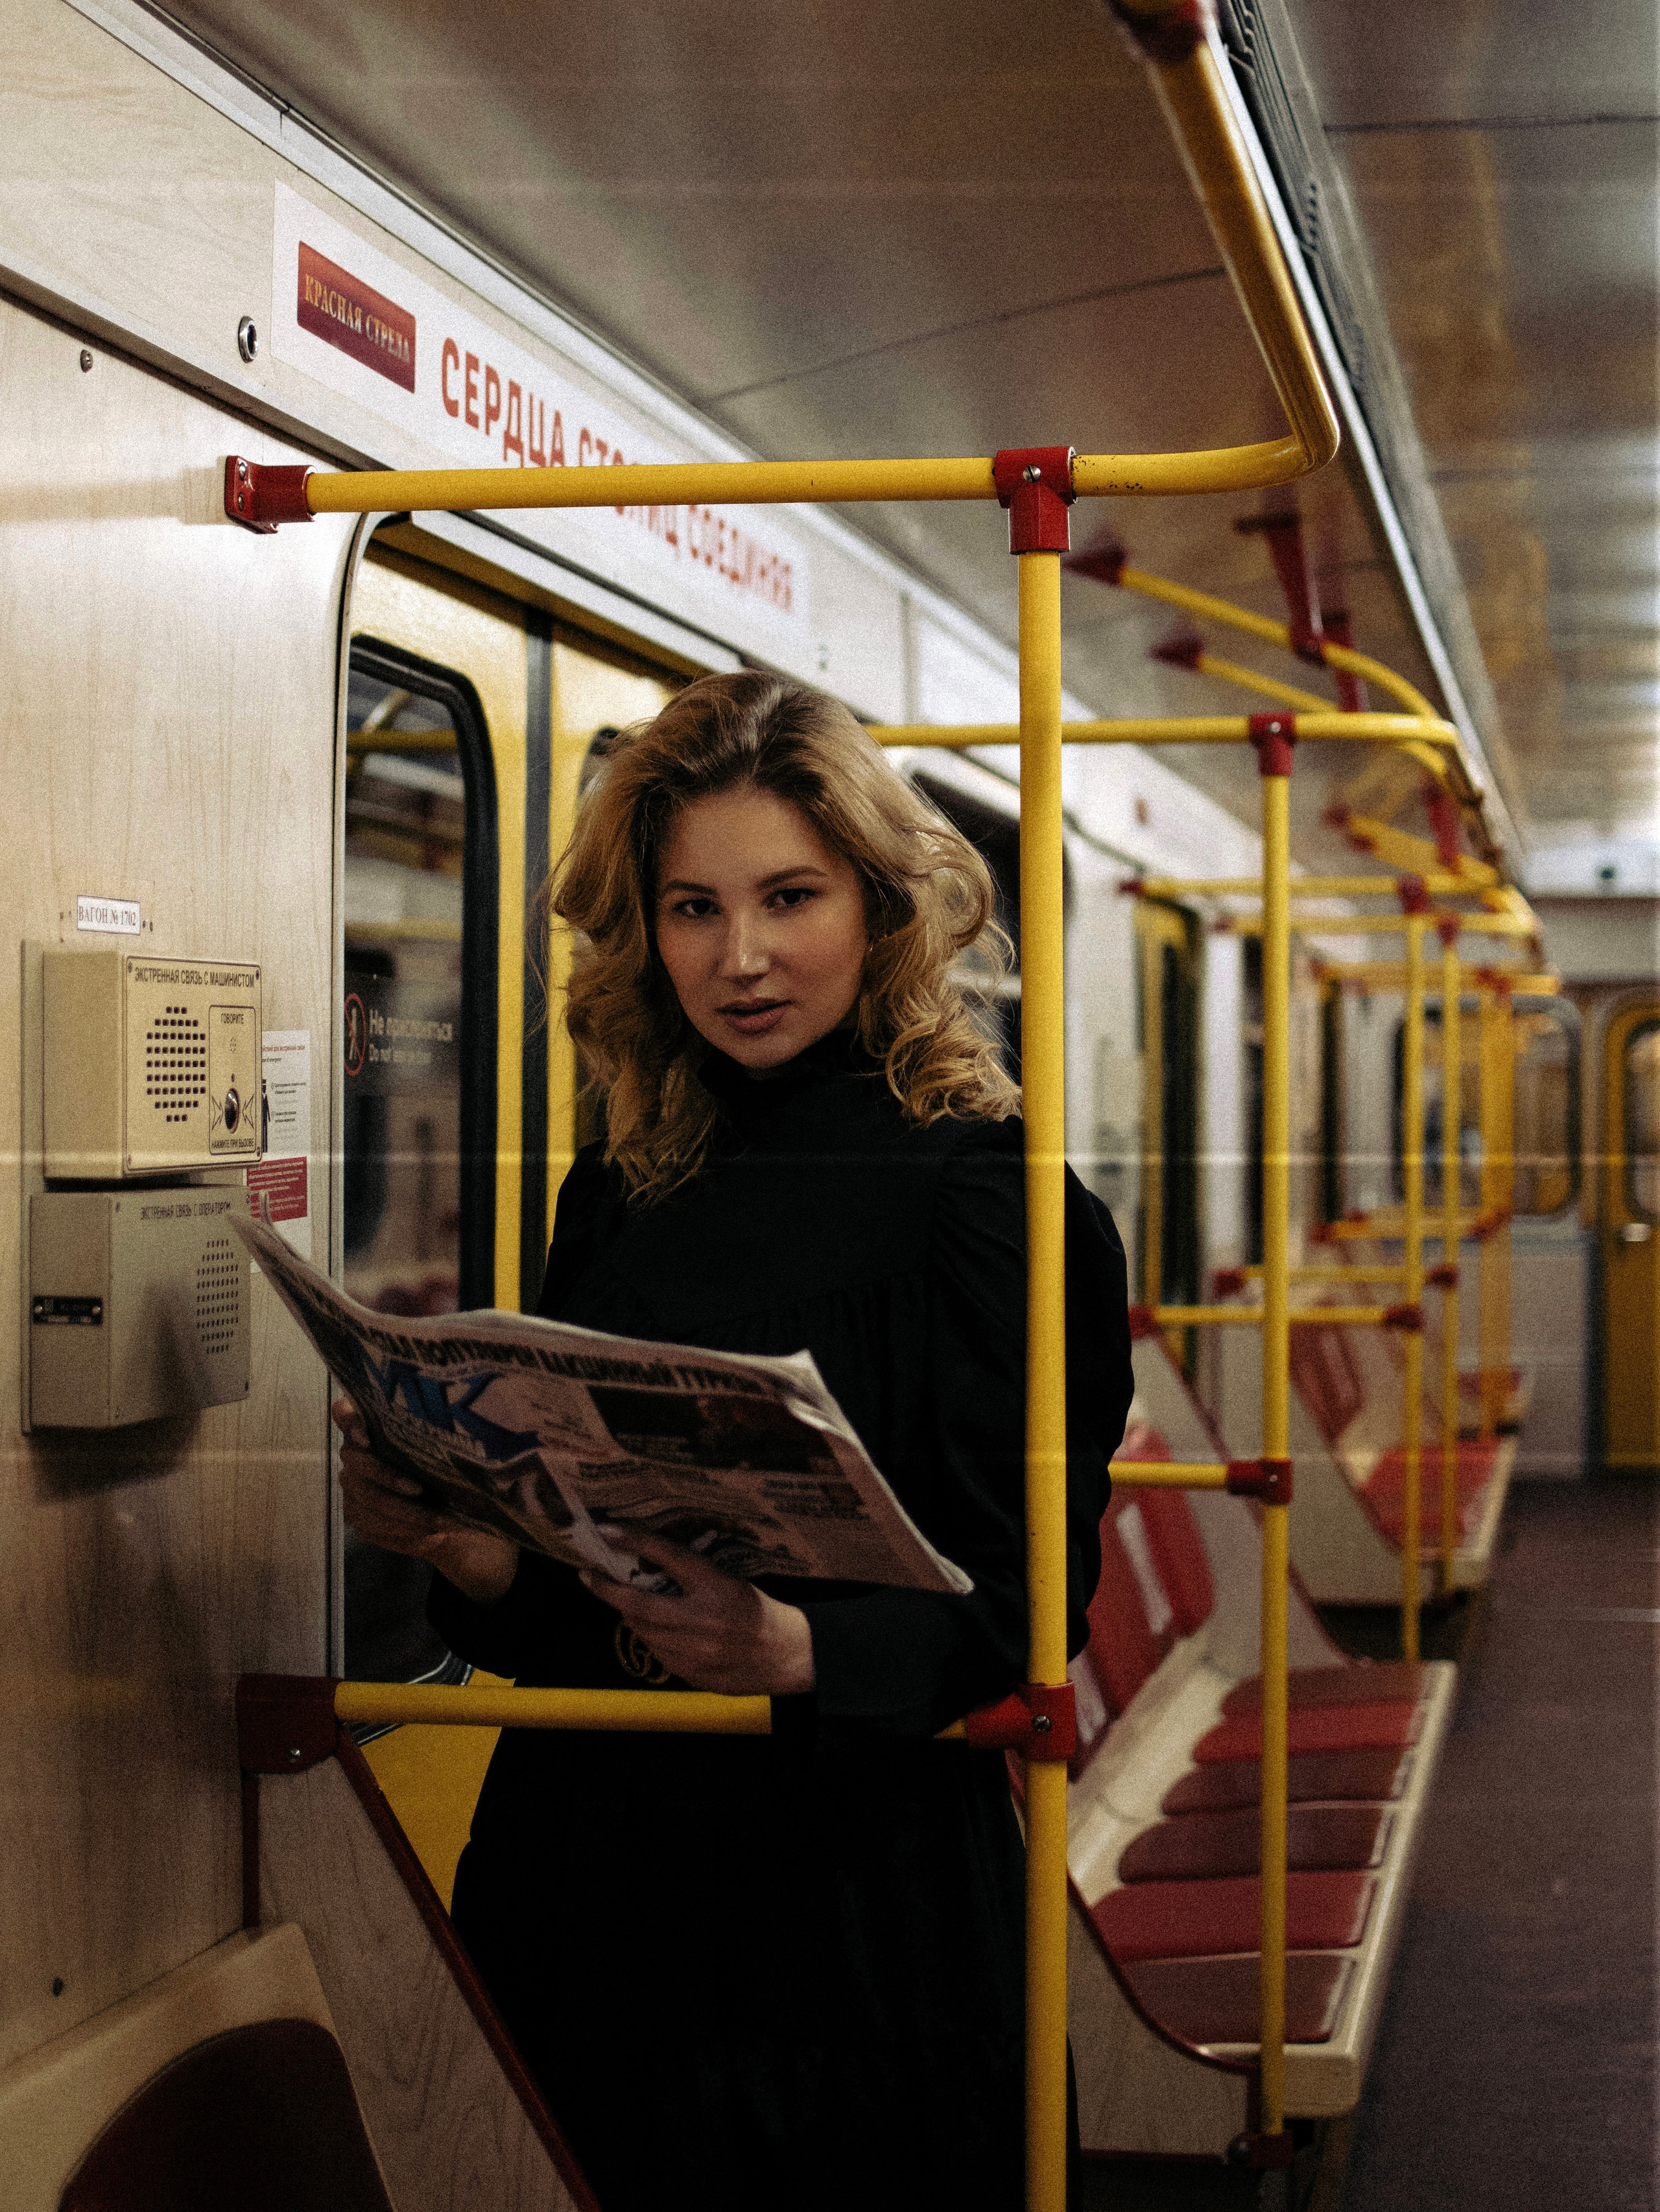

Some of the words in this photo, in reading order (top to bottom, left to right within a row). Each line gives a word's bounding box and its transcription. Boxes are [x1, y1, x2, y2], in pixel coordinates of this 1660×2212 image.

[305, 274, 362, 333] КРАСНАЯ
[366, 314, 410, 363] СТРЕЛА
[442, 337, 565, 467] СЕРДЦА
[78, 906, 108, 924] ВАГОН
[121, 912, 136, 926] 1702
[135, 967, 180, 985] ЭКСТРЕННАЯ
[182, 970, 202, 985] СВЯЗЬ
[204, 972, 209, 985] С
[209, 972, 254, 988] МАШИНИСТОМ
[141, 1205, 174, 1220] ЭКСТРЕННАЯ
[176, 1204, 192, 1218] СВЯЗЬ
